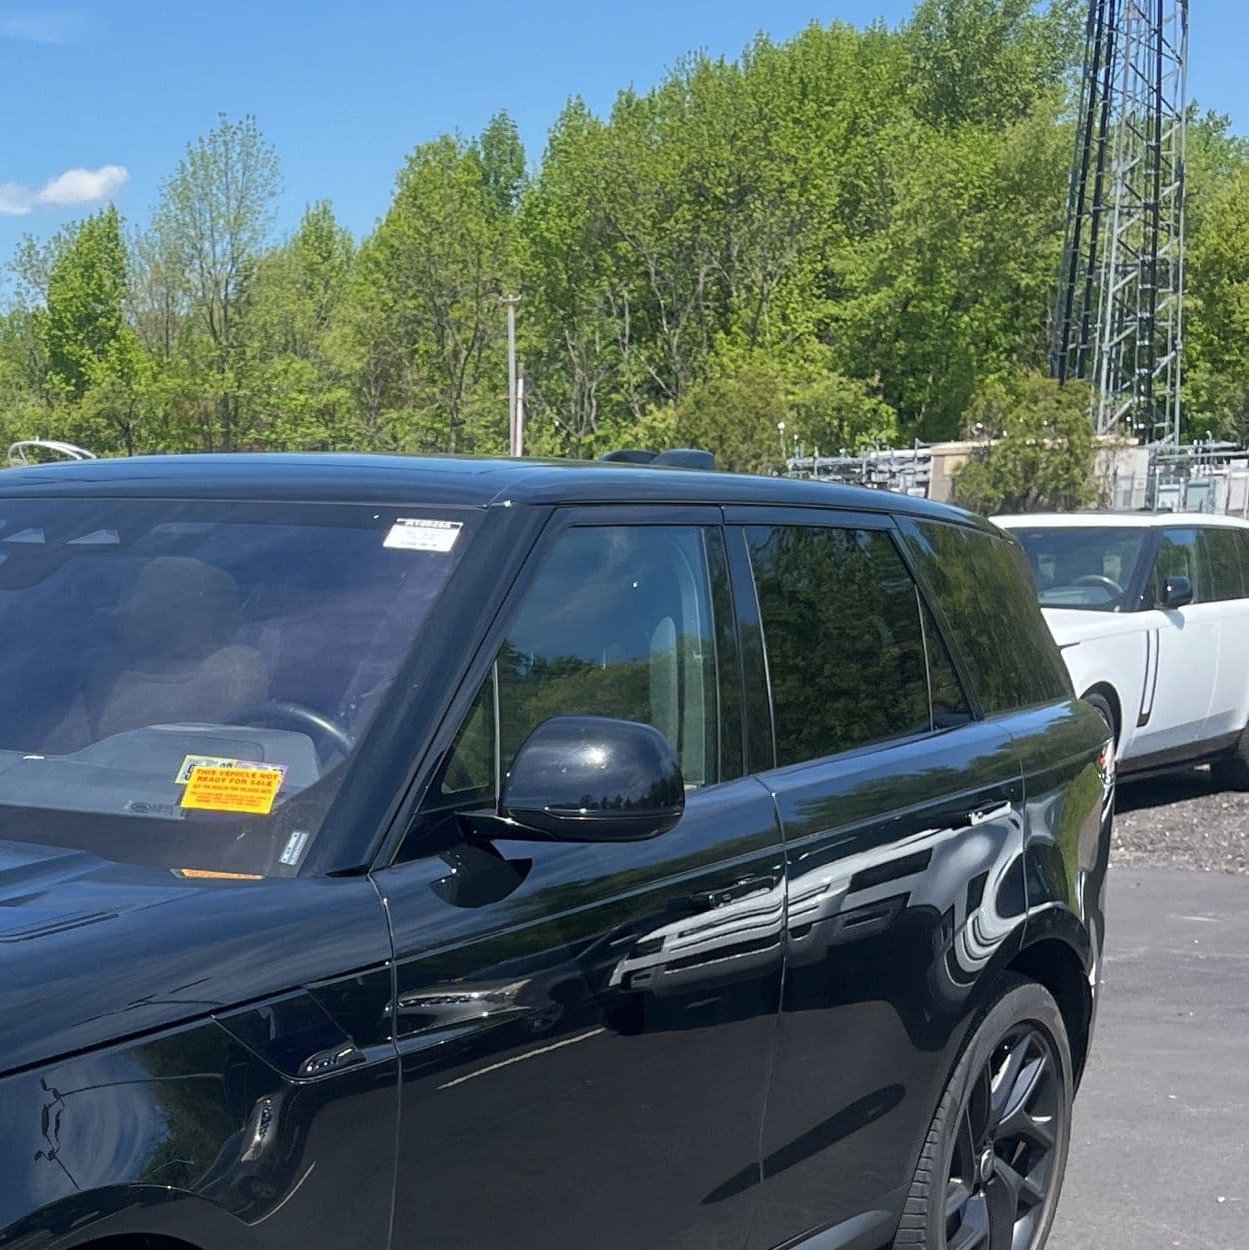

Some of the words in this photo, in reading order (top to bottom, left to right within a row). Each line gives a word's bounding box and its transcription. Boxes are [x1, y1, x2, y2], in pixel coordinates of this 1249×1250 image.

[196, 768, 217, 776] THIS
[219, 769, 257, 779] VEHICLE
[260, 772, 279, 780] NOT
[228, 777, 248, 785] FOR
[250, 779, 273, 787] SALE
